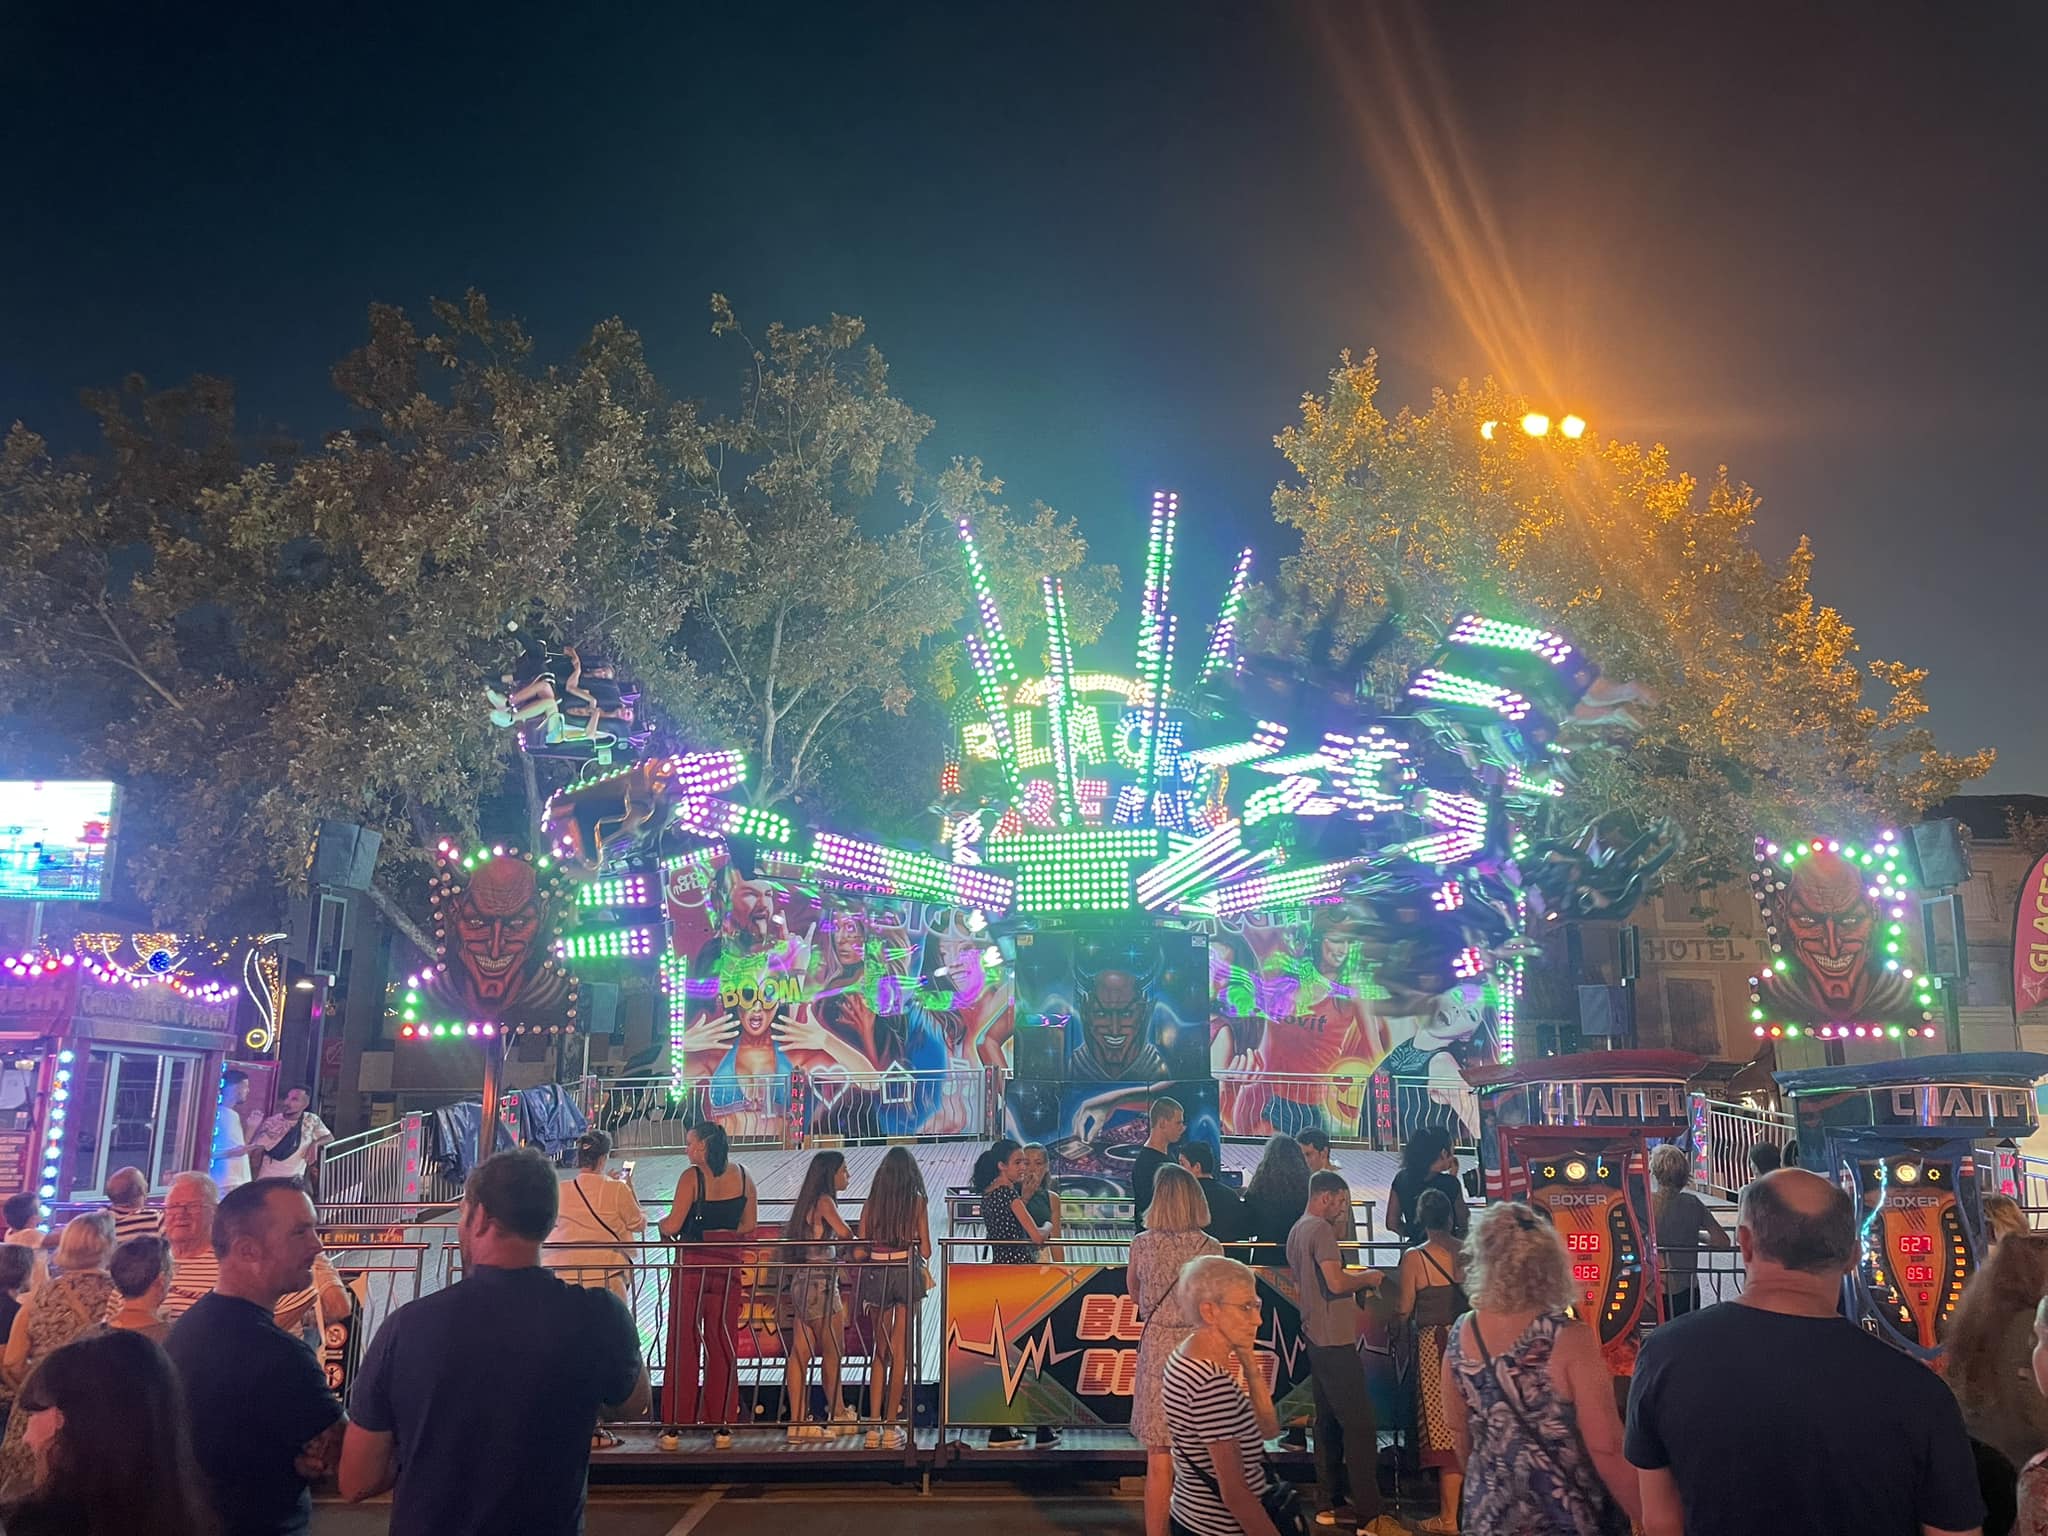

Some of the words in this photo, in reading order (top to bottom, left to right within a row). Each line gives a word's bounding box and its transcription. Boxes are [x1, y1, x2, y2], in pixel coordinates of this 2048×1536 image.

[990, 778, 1192, 836] REAM
[2028, 862, 2048, 974] GLAC
[1645, 939, 1745, 961] HOTEL
[721, 976, 801, 1009] BOOM
[1550, 1194, 1608, 1206] BOXER
[1885, 1196, 1940, 1207] BOXER
[1568, 1235, 1599, 1250] 369
[1900, 1236, 1932, 1252] 627
[1574, 1265, 1599, 1279] 362
[1906, 1267, 1933, 1280] 851
